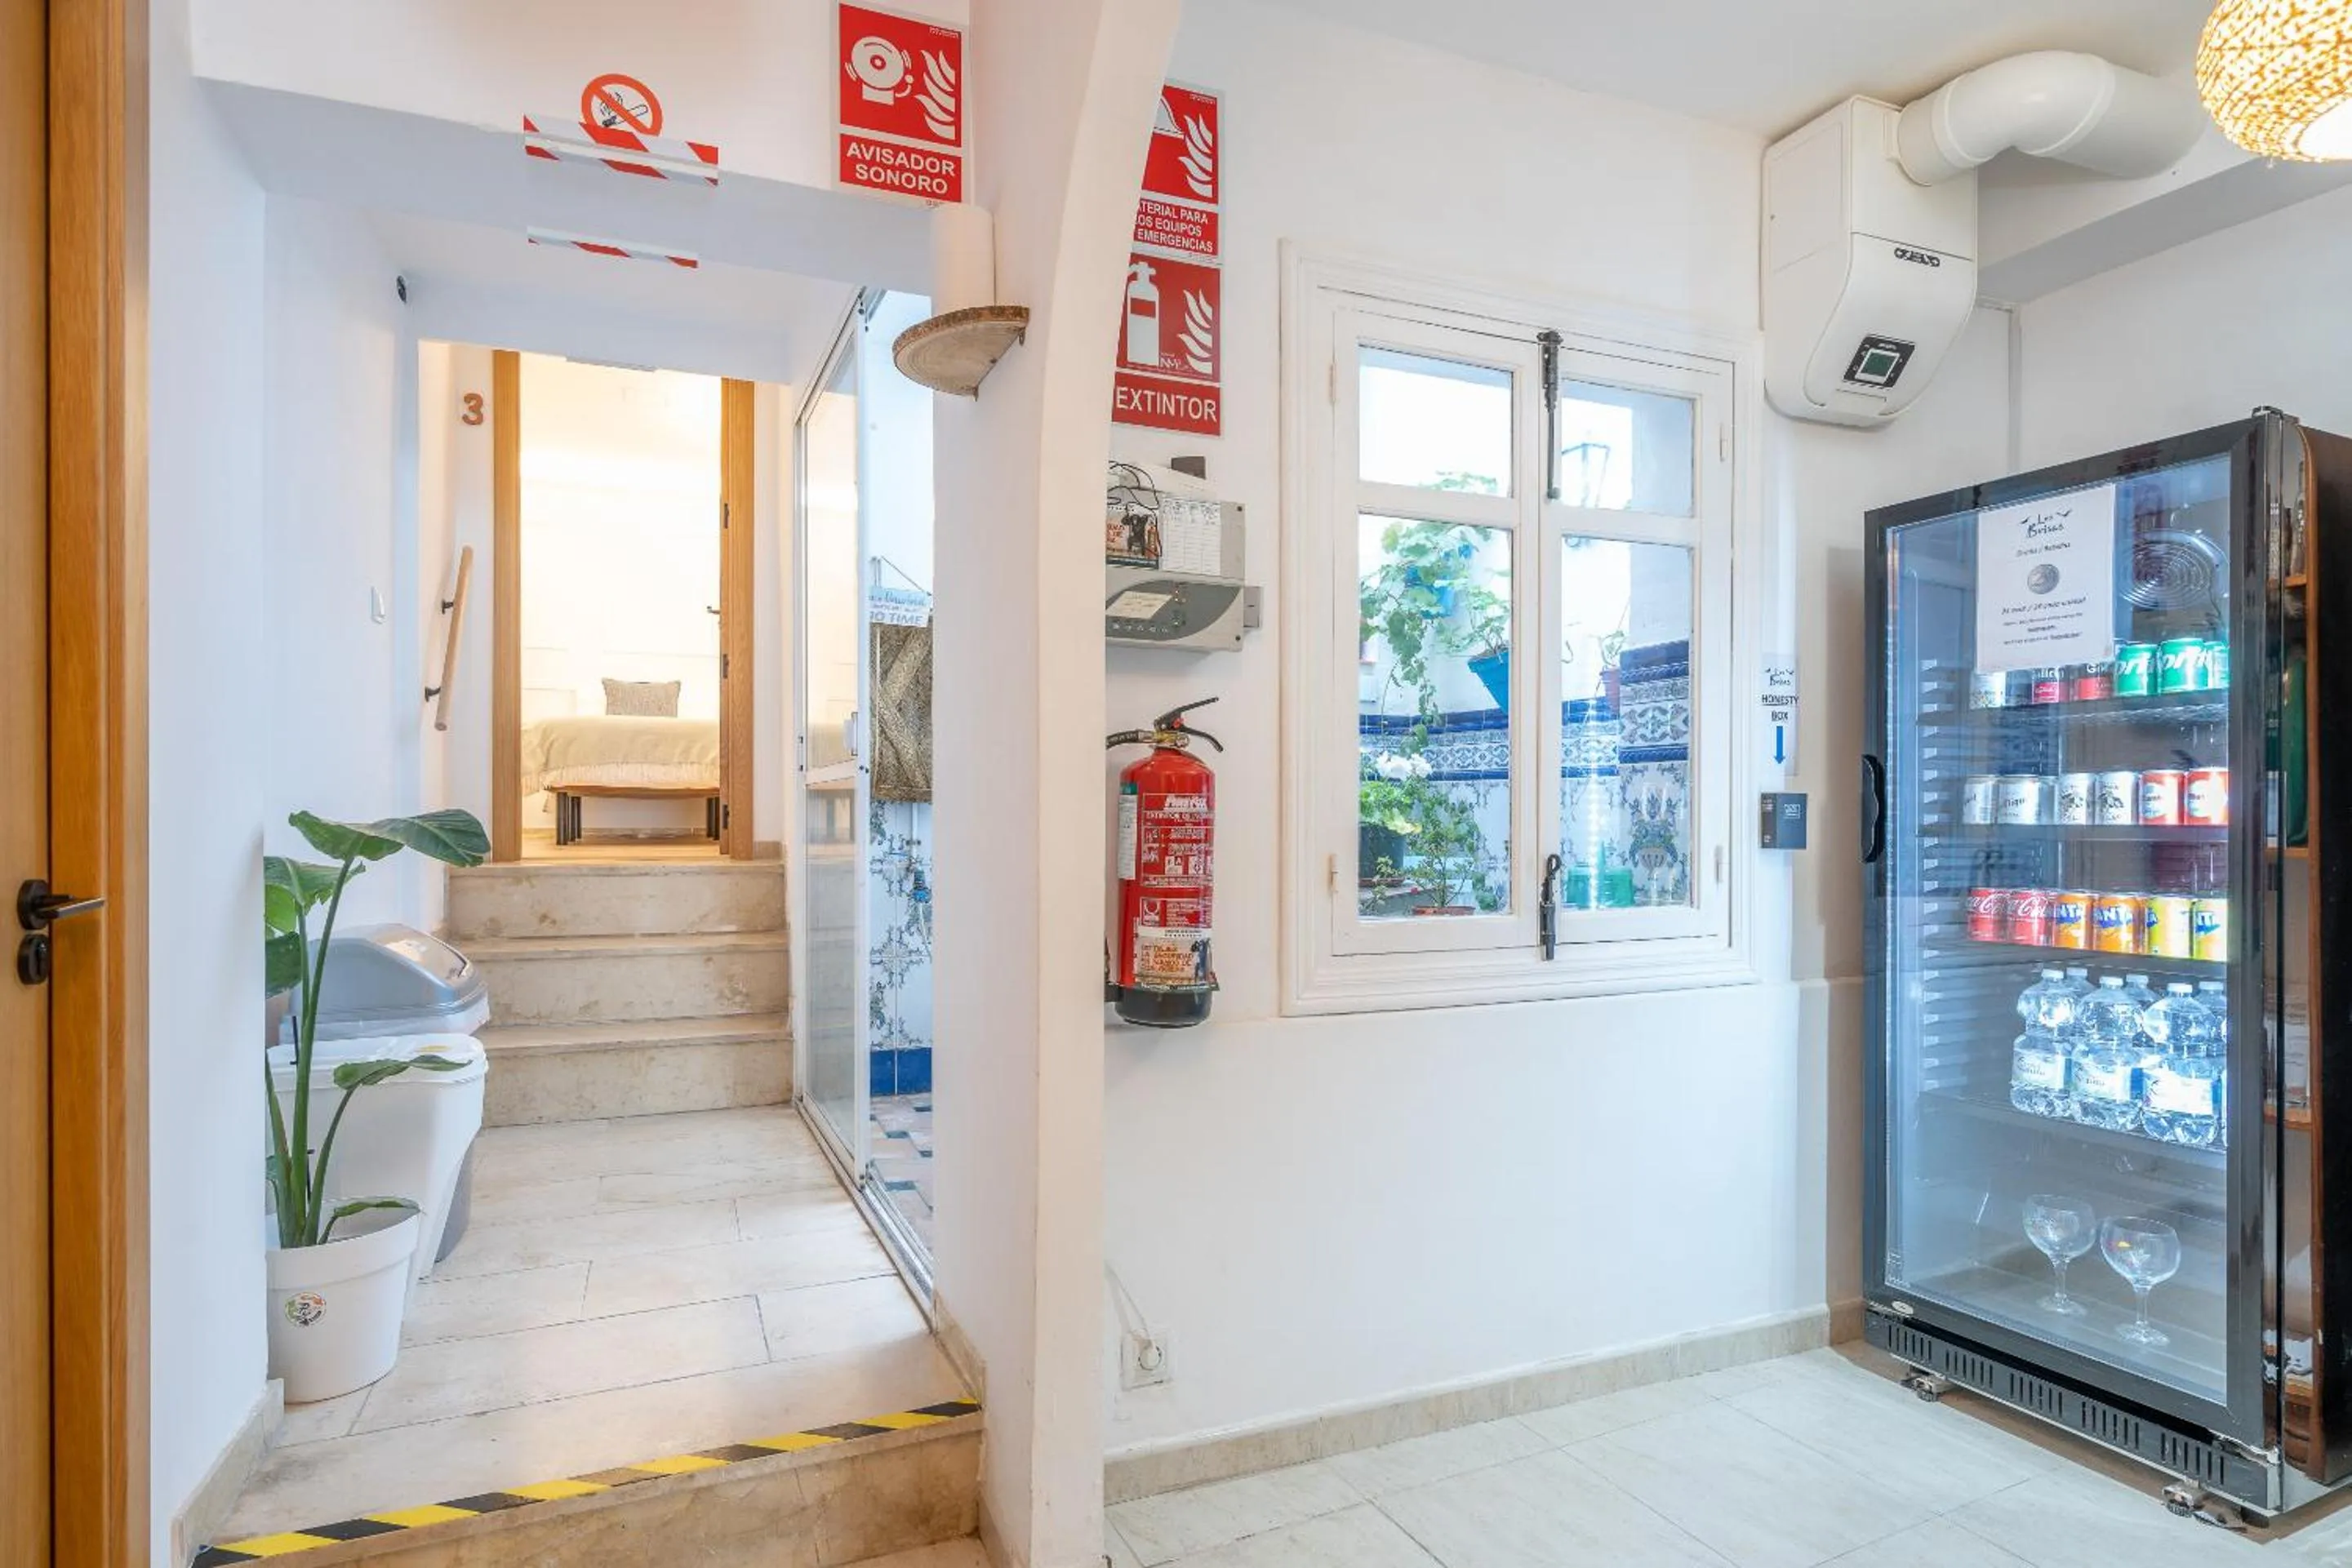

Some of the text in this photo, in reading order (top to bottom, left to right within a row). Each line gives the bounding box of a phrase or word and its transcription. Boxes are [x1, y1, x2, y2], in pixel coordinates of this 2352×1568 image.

[847, 141, 955, 176] AVISADOR
[855, 163, 948, 194] SONORO
[1136, 214, 1202, 237] OS EQUIPOS
[1180, 208, 1208, 224] PARA
[1137, 229, 1213, 253] EMERGENCIAS
[462, 393, 483, 425] 3
[1116, 386, 1217, 422] EXTINTOR
[889, 613, 924, 624] TIME
[1761, 694, 1799, 704] HONESTY
[1772, 710, 1789, 721] BOX
